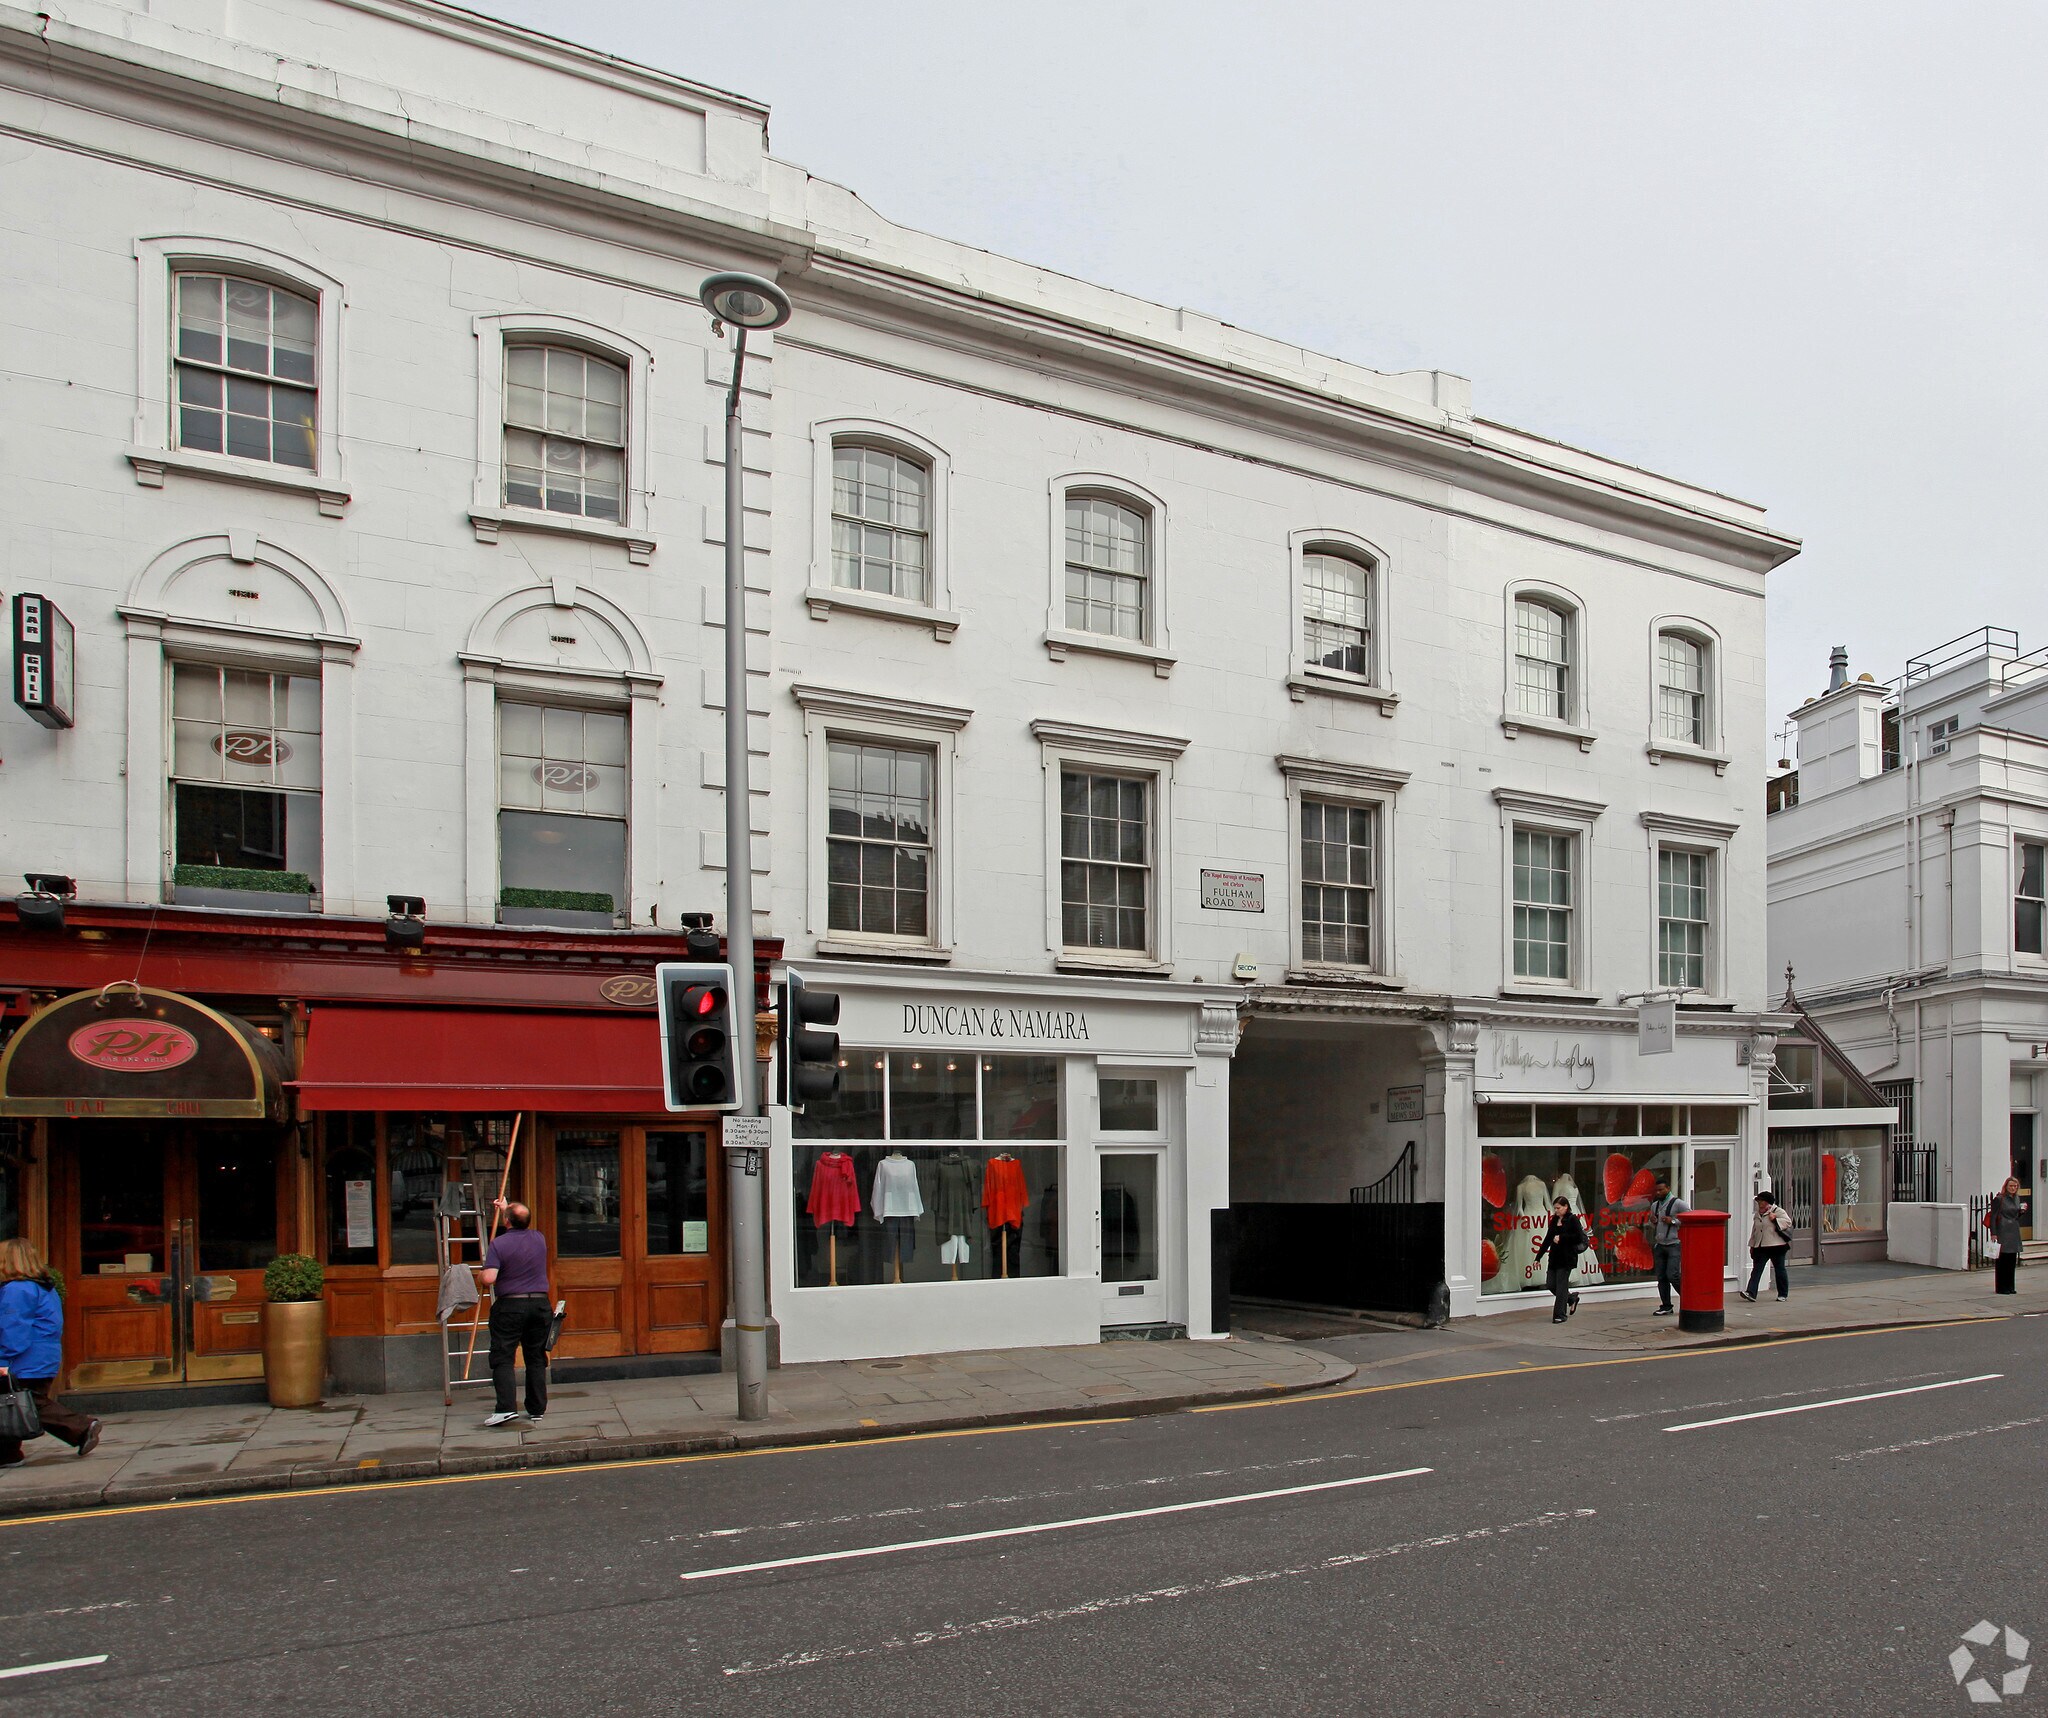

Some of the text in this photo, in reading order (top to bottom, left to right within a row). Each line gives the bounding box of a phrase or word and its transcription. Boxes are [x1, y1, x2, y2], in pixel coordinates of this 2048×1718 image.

[26, 605, 39, 635] BAR
[26, 656, 39, 701] GRILL
[1213, 888, 1253, 899] FULHAM
[902, 1004, 1090, 1040] DUNCAN & NAMARA
[87, 1029, 184, 1057] PJ's
